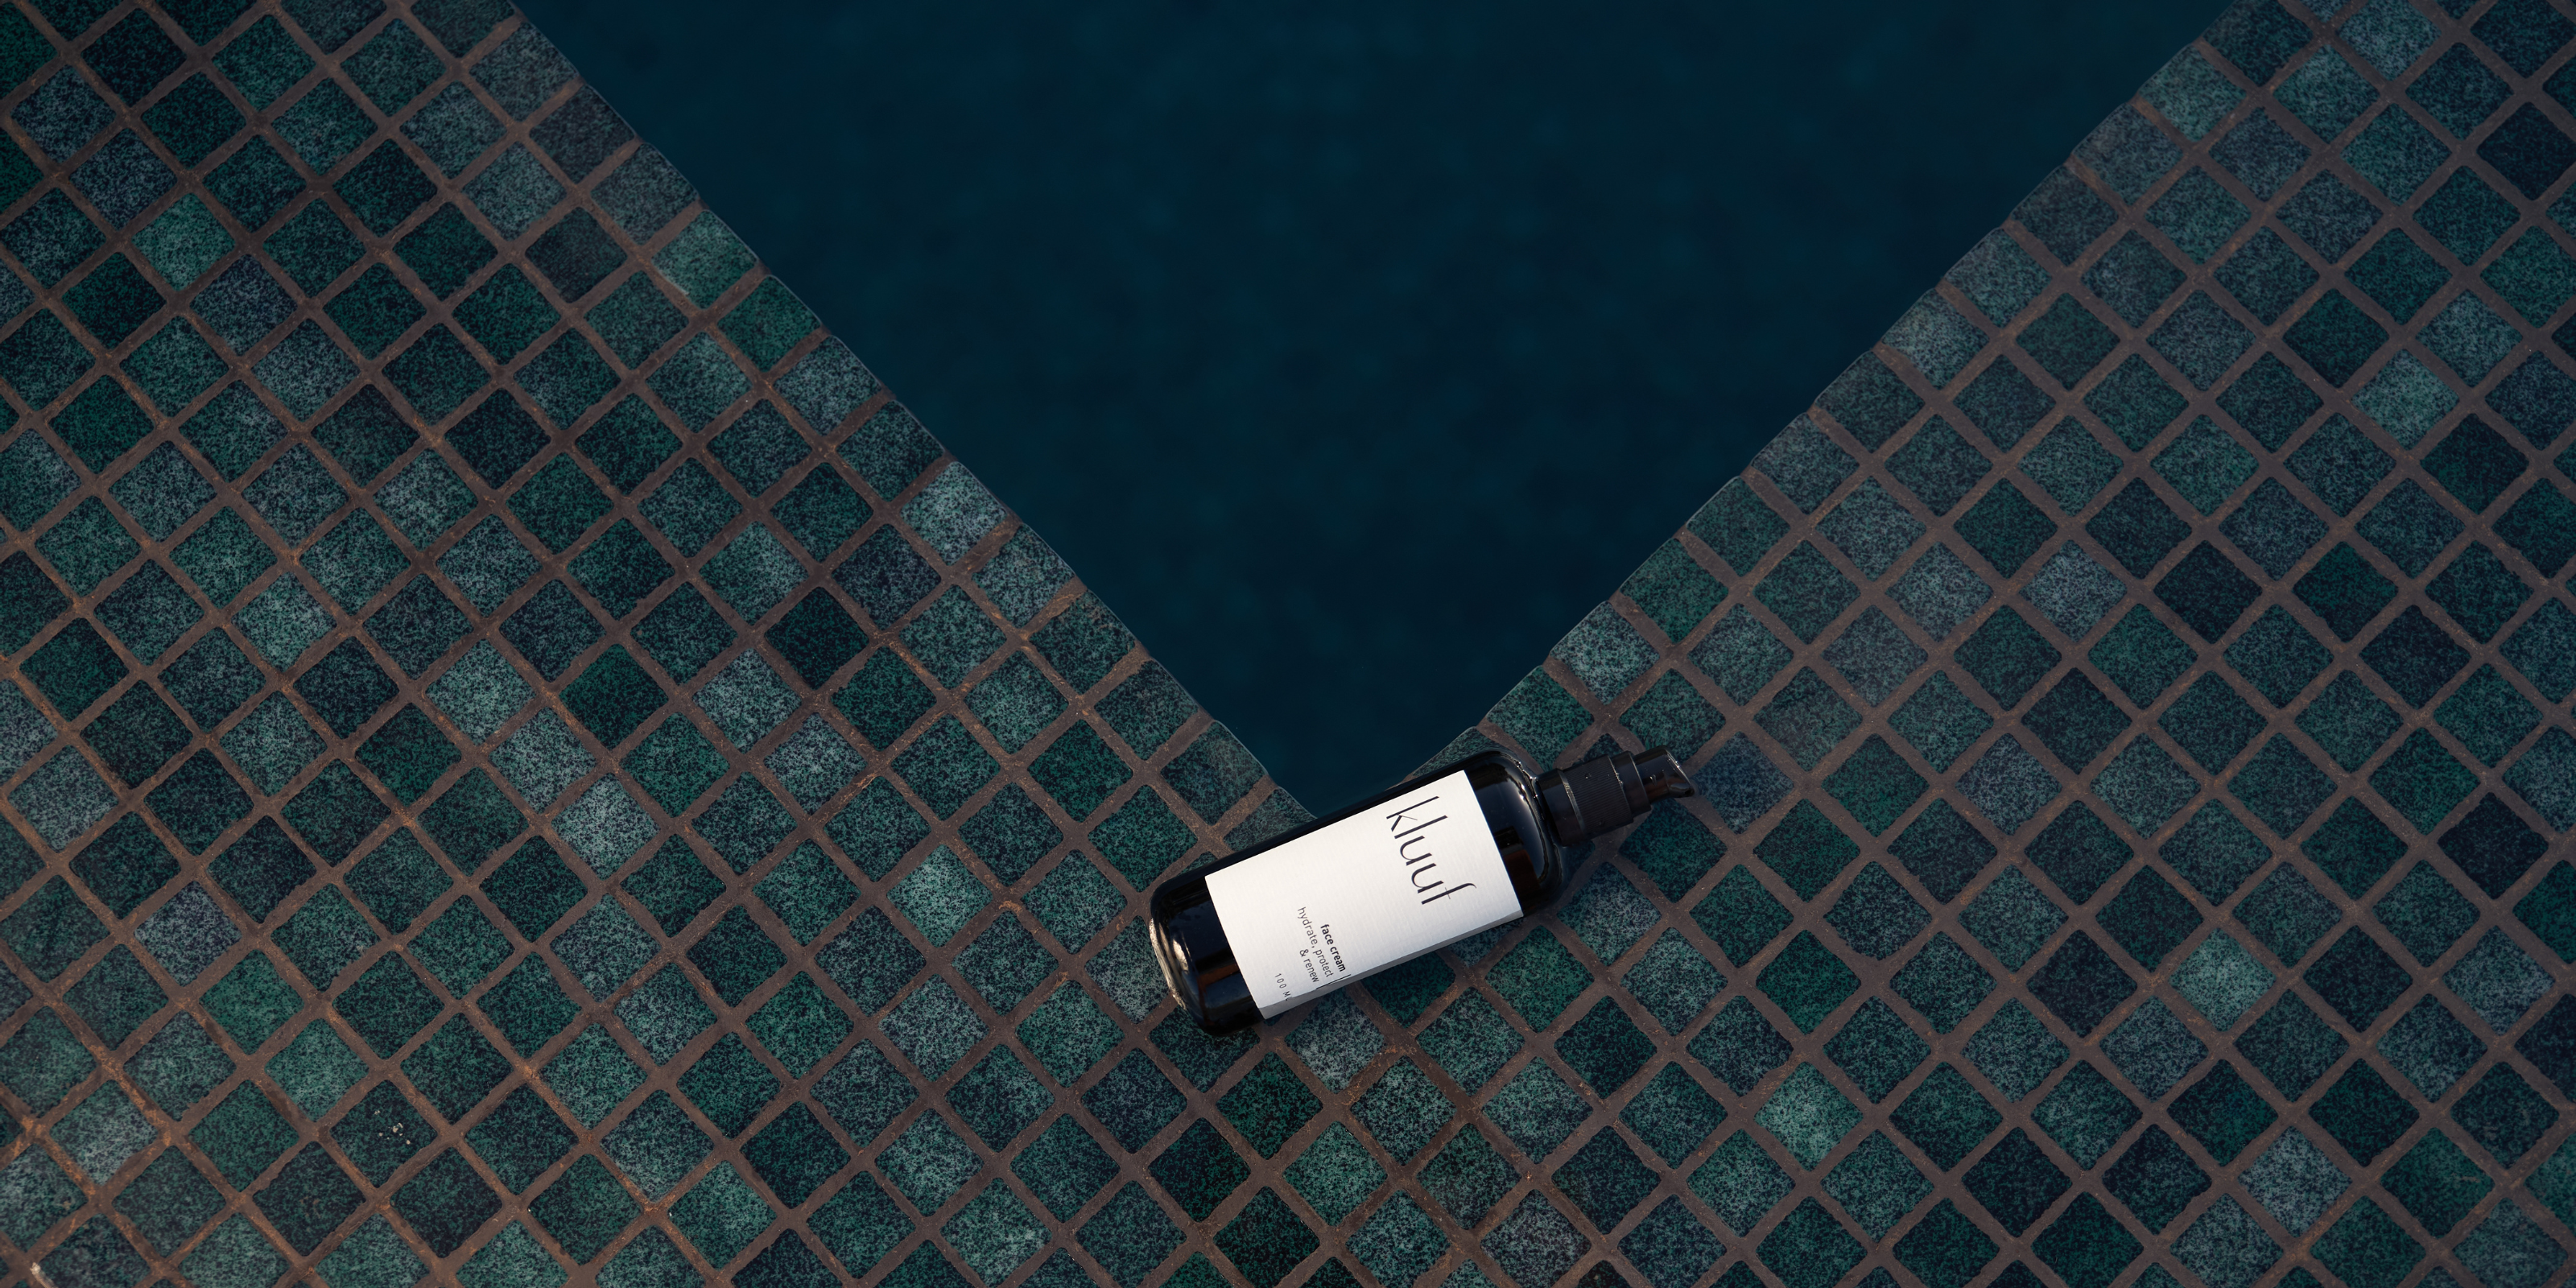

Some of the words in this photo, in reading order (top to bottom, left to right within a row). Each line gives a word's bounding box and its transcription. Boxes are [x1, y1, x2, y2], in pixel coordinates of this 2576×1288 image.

[1386, 795, 1476, 905] kluuf
[1297, 906, 1318, 948] hydrate,
[1312, 949, 1334, 977] protect
[1299, 948, 1309, 957] &
[1320, 923, 1334, 945] face
[1330, 946, 1346, 972] cream
[1274, 972, 1287, 989] 100
[1303, 959, 1319, 983] renew
